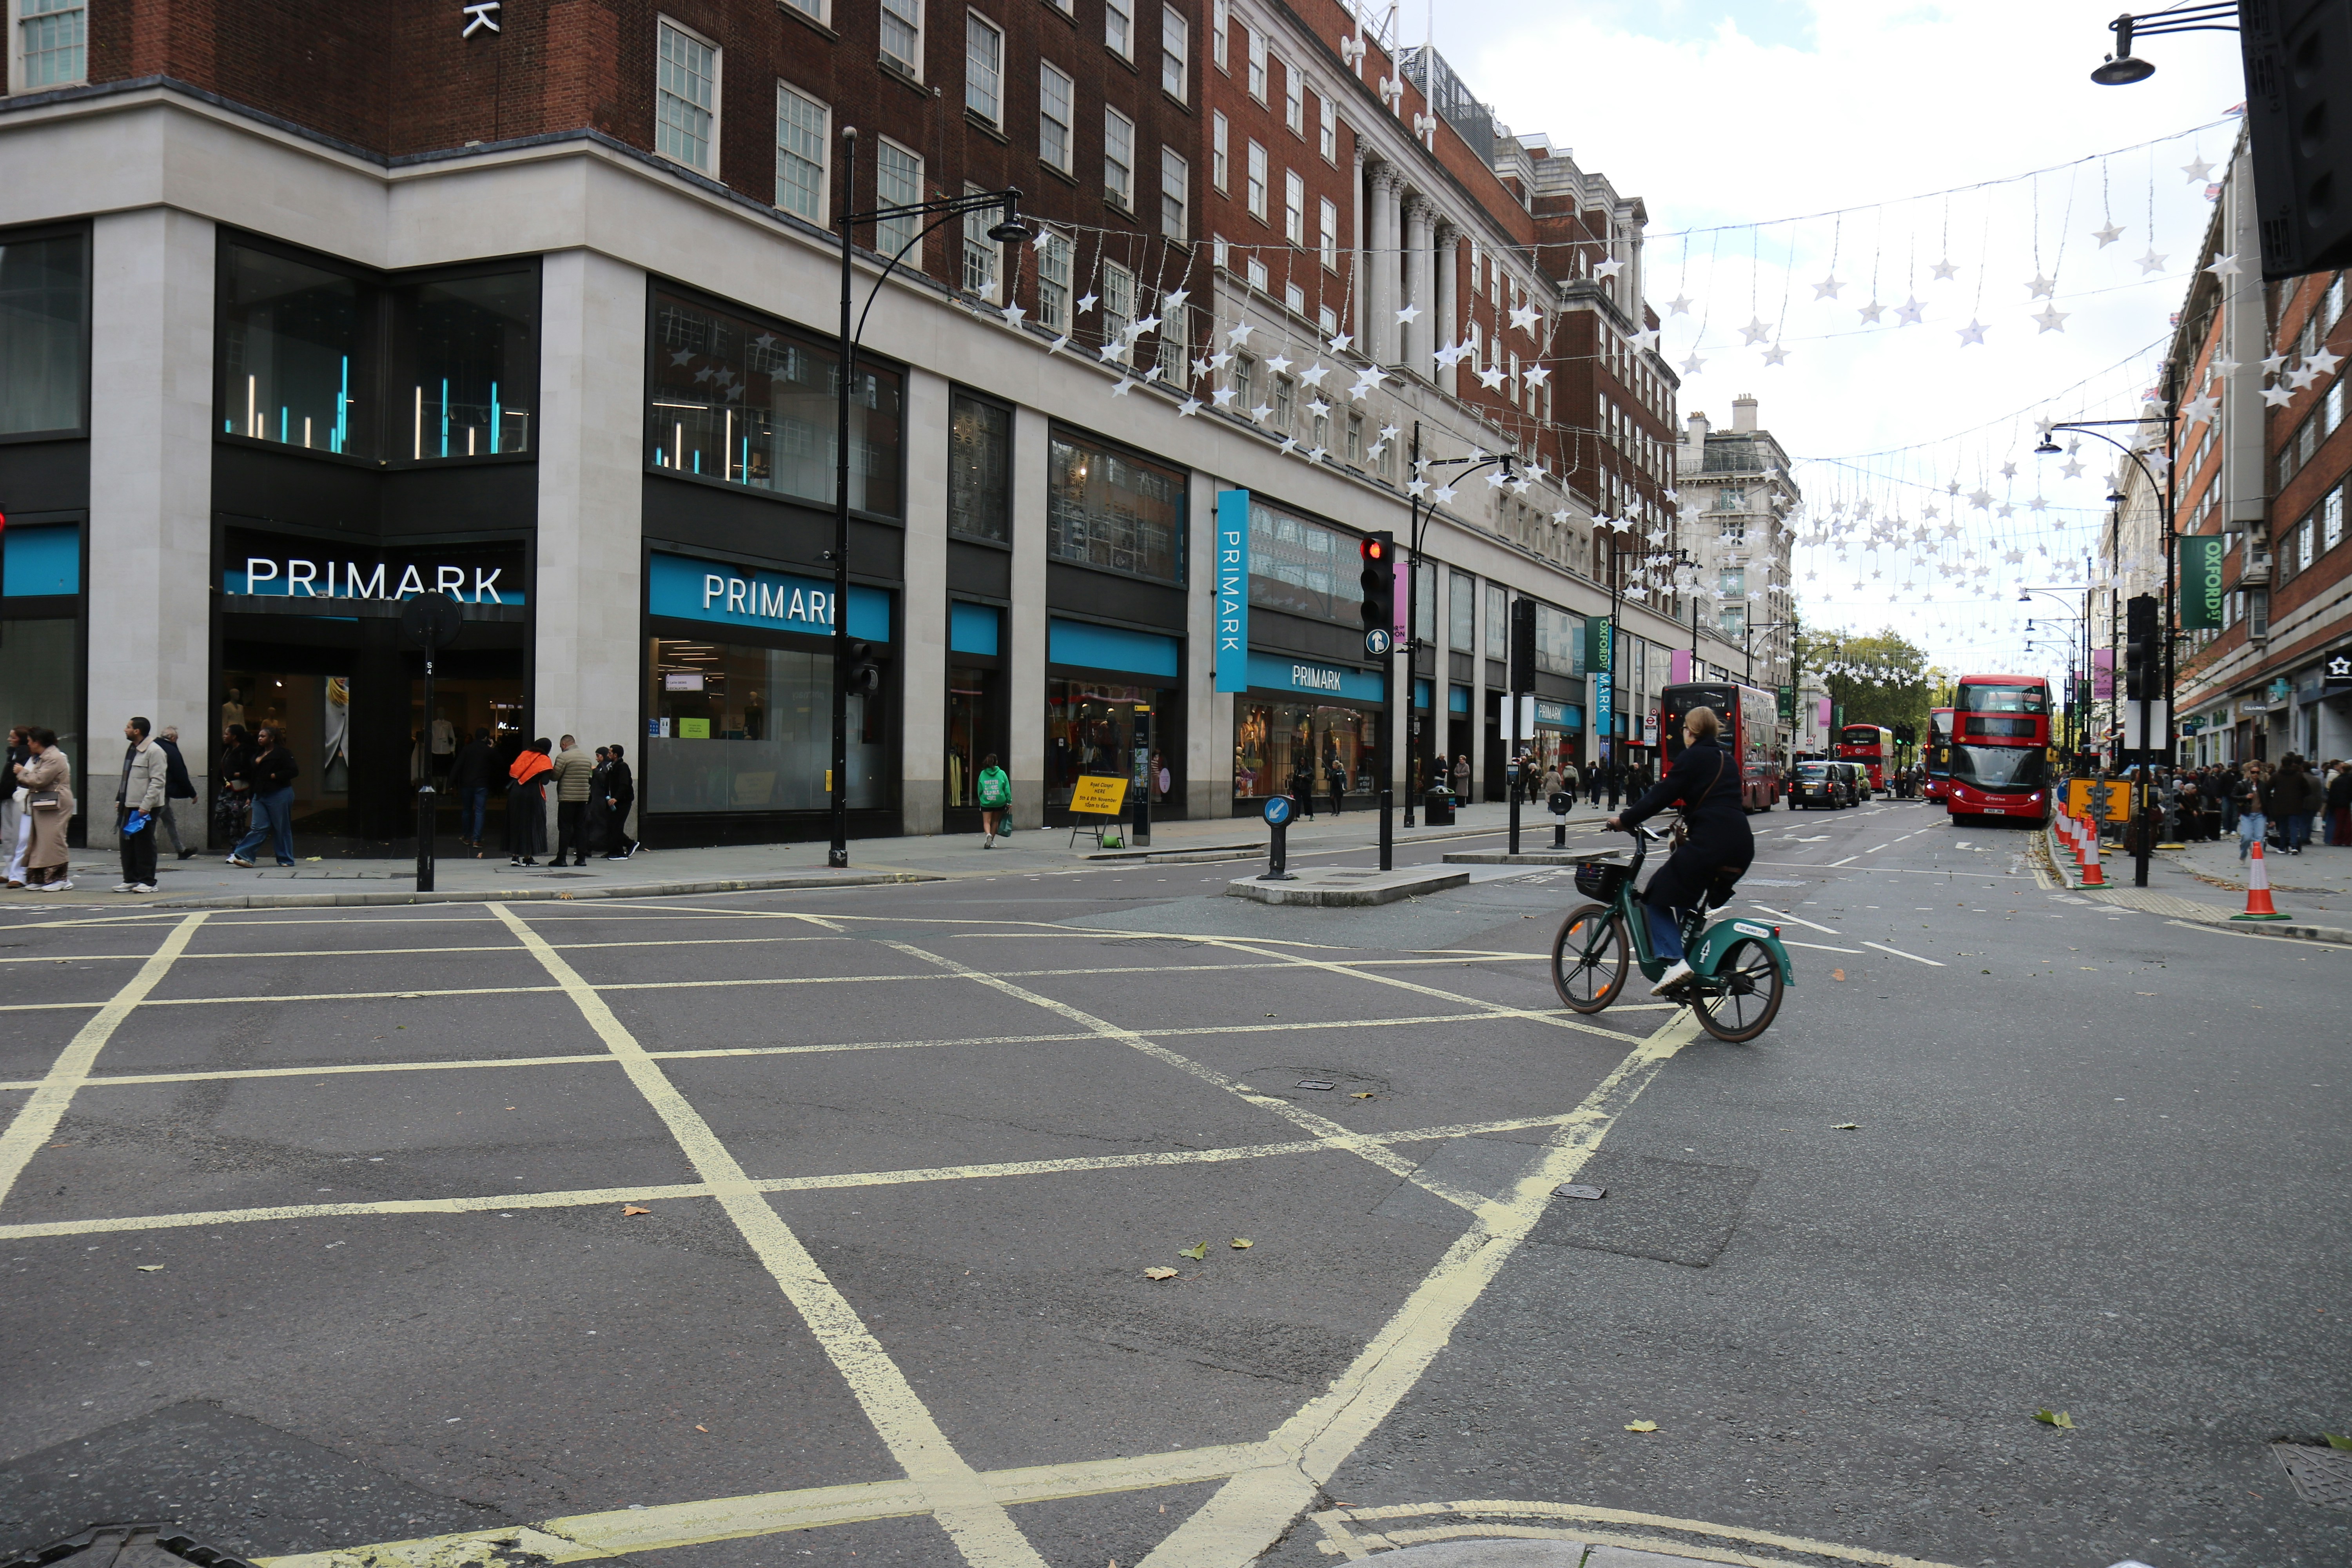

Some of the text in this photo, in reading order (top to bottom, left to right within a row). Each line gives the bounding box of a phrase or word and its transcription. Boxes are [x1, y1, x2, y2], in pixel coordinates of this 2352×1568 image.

[247, 558, 502, 604] PRIMARK
[1222, 531, 1240, 651] PRIMARK
[2204, 541, 2222, 610] OXFORD
[1599, 619, 1609, 661] OXFORD
[1292, 665, 1341, 691] PRIMARK
[1538, 704, 1561, 720] PRIMARK
